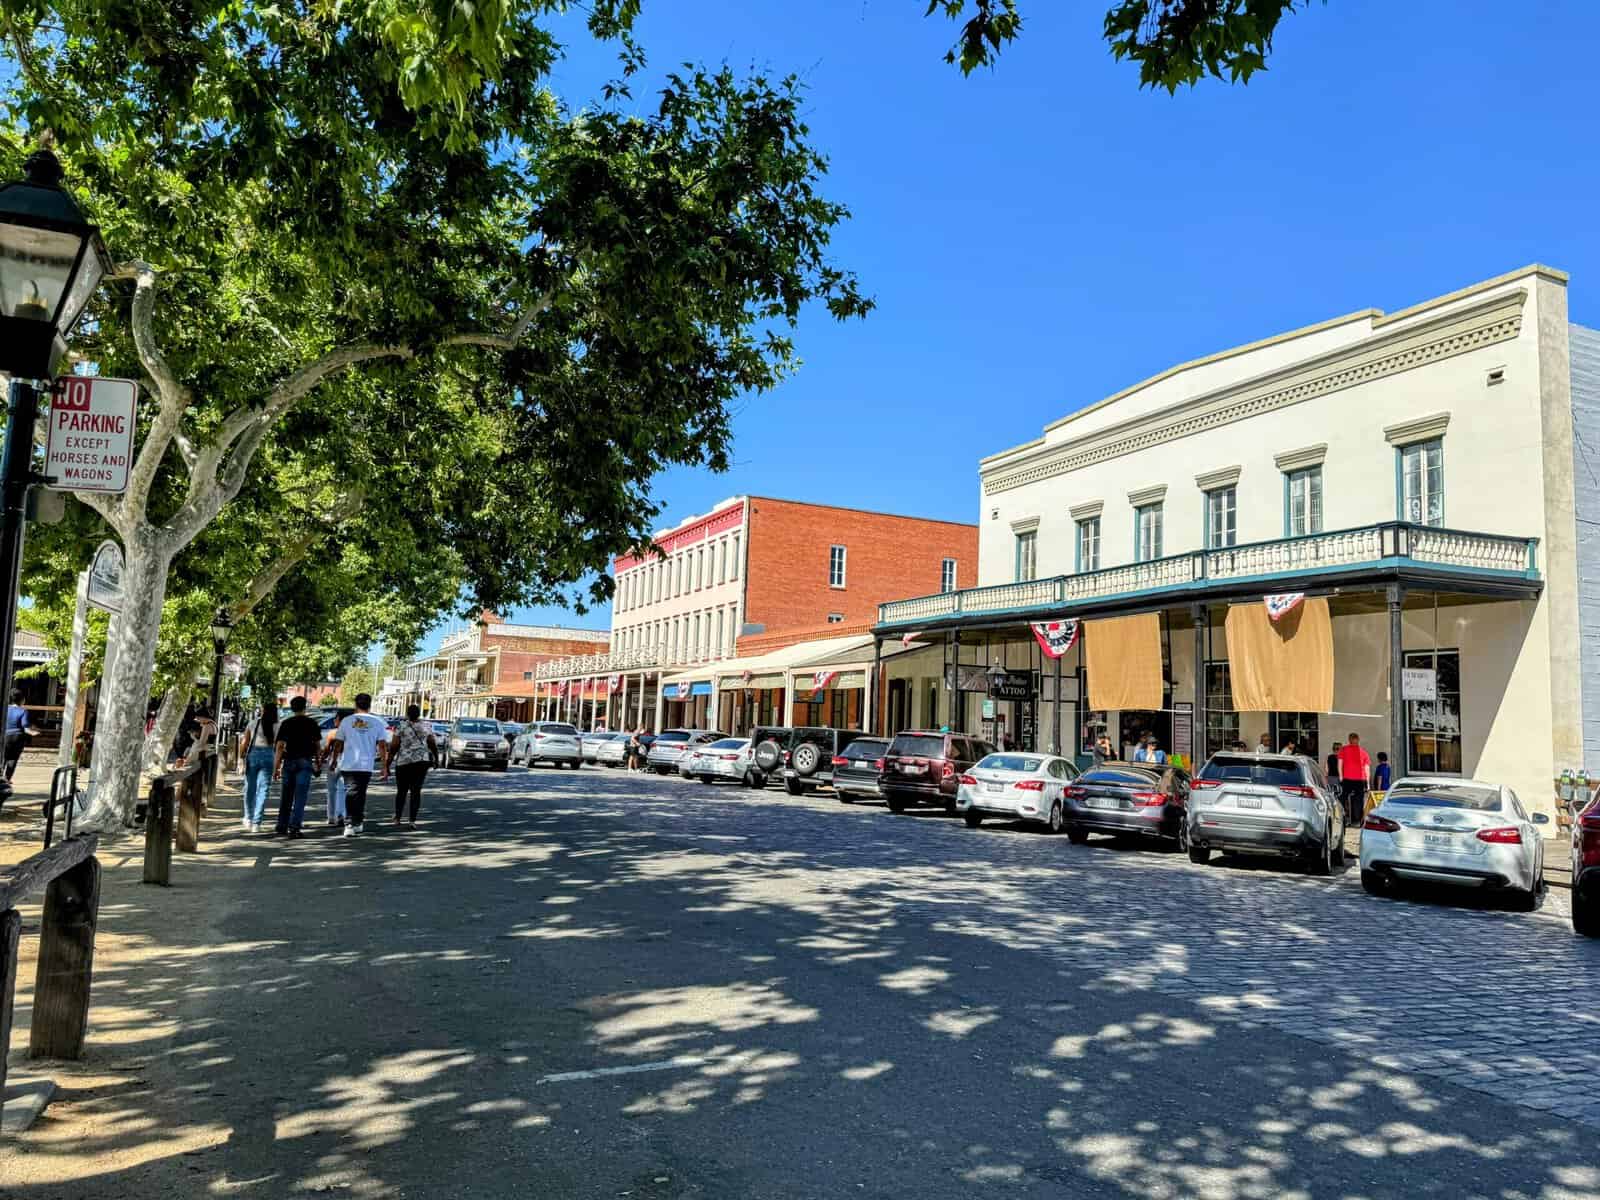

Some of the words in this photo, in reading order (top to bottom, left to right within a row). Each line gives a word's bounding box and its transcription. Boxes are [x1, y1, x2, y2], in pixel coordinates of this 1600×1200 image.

[56, 381, 87, 407] NO
[58, 411, 126, 434] PARKING
[65, 436, 112, 450] EXCEPT
[50, 451, 98, 465] HORSES
[102, 454, 126, 467] AND
[64, 468, 113, 481] WAGONS
